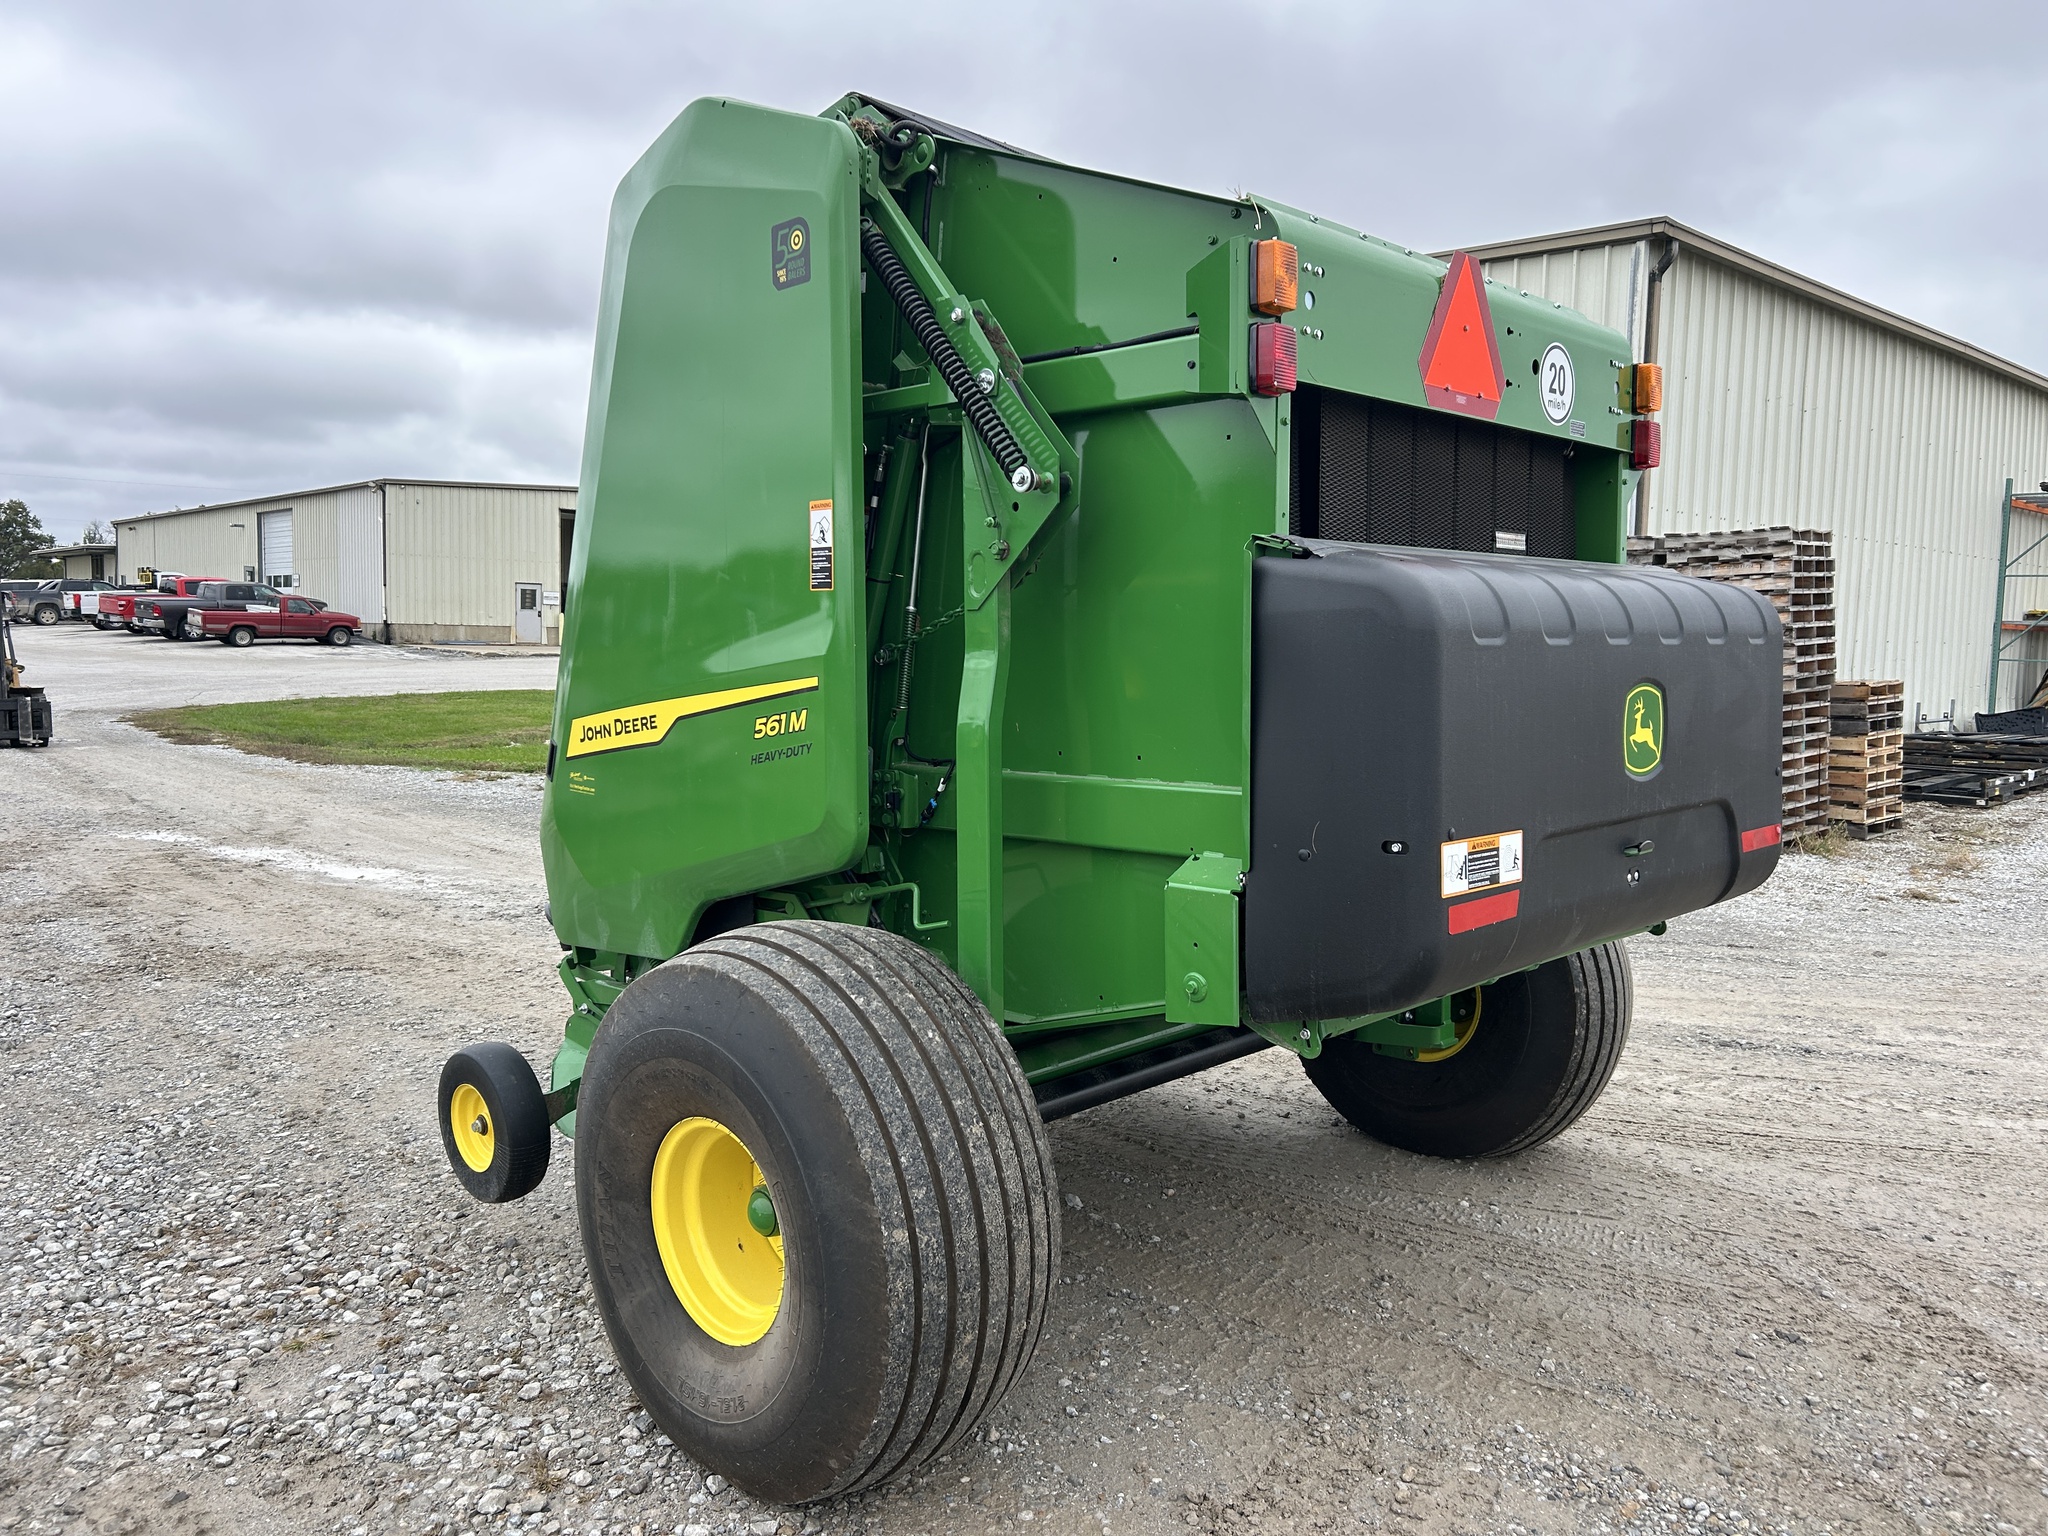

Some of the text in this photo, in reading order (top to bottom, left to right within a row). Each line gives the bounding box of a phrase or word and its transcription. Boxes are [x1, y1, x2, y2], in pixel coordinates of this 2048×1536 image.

[775, 224, 806, 269] 50
[1549, 362, 1566, 397] 20
[580, 714, 658, 743] JOHN DEERE
[750, 742, 813, 766] HEAVY-DUTY
